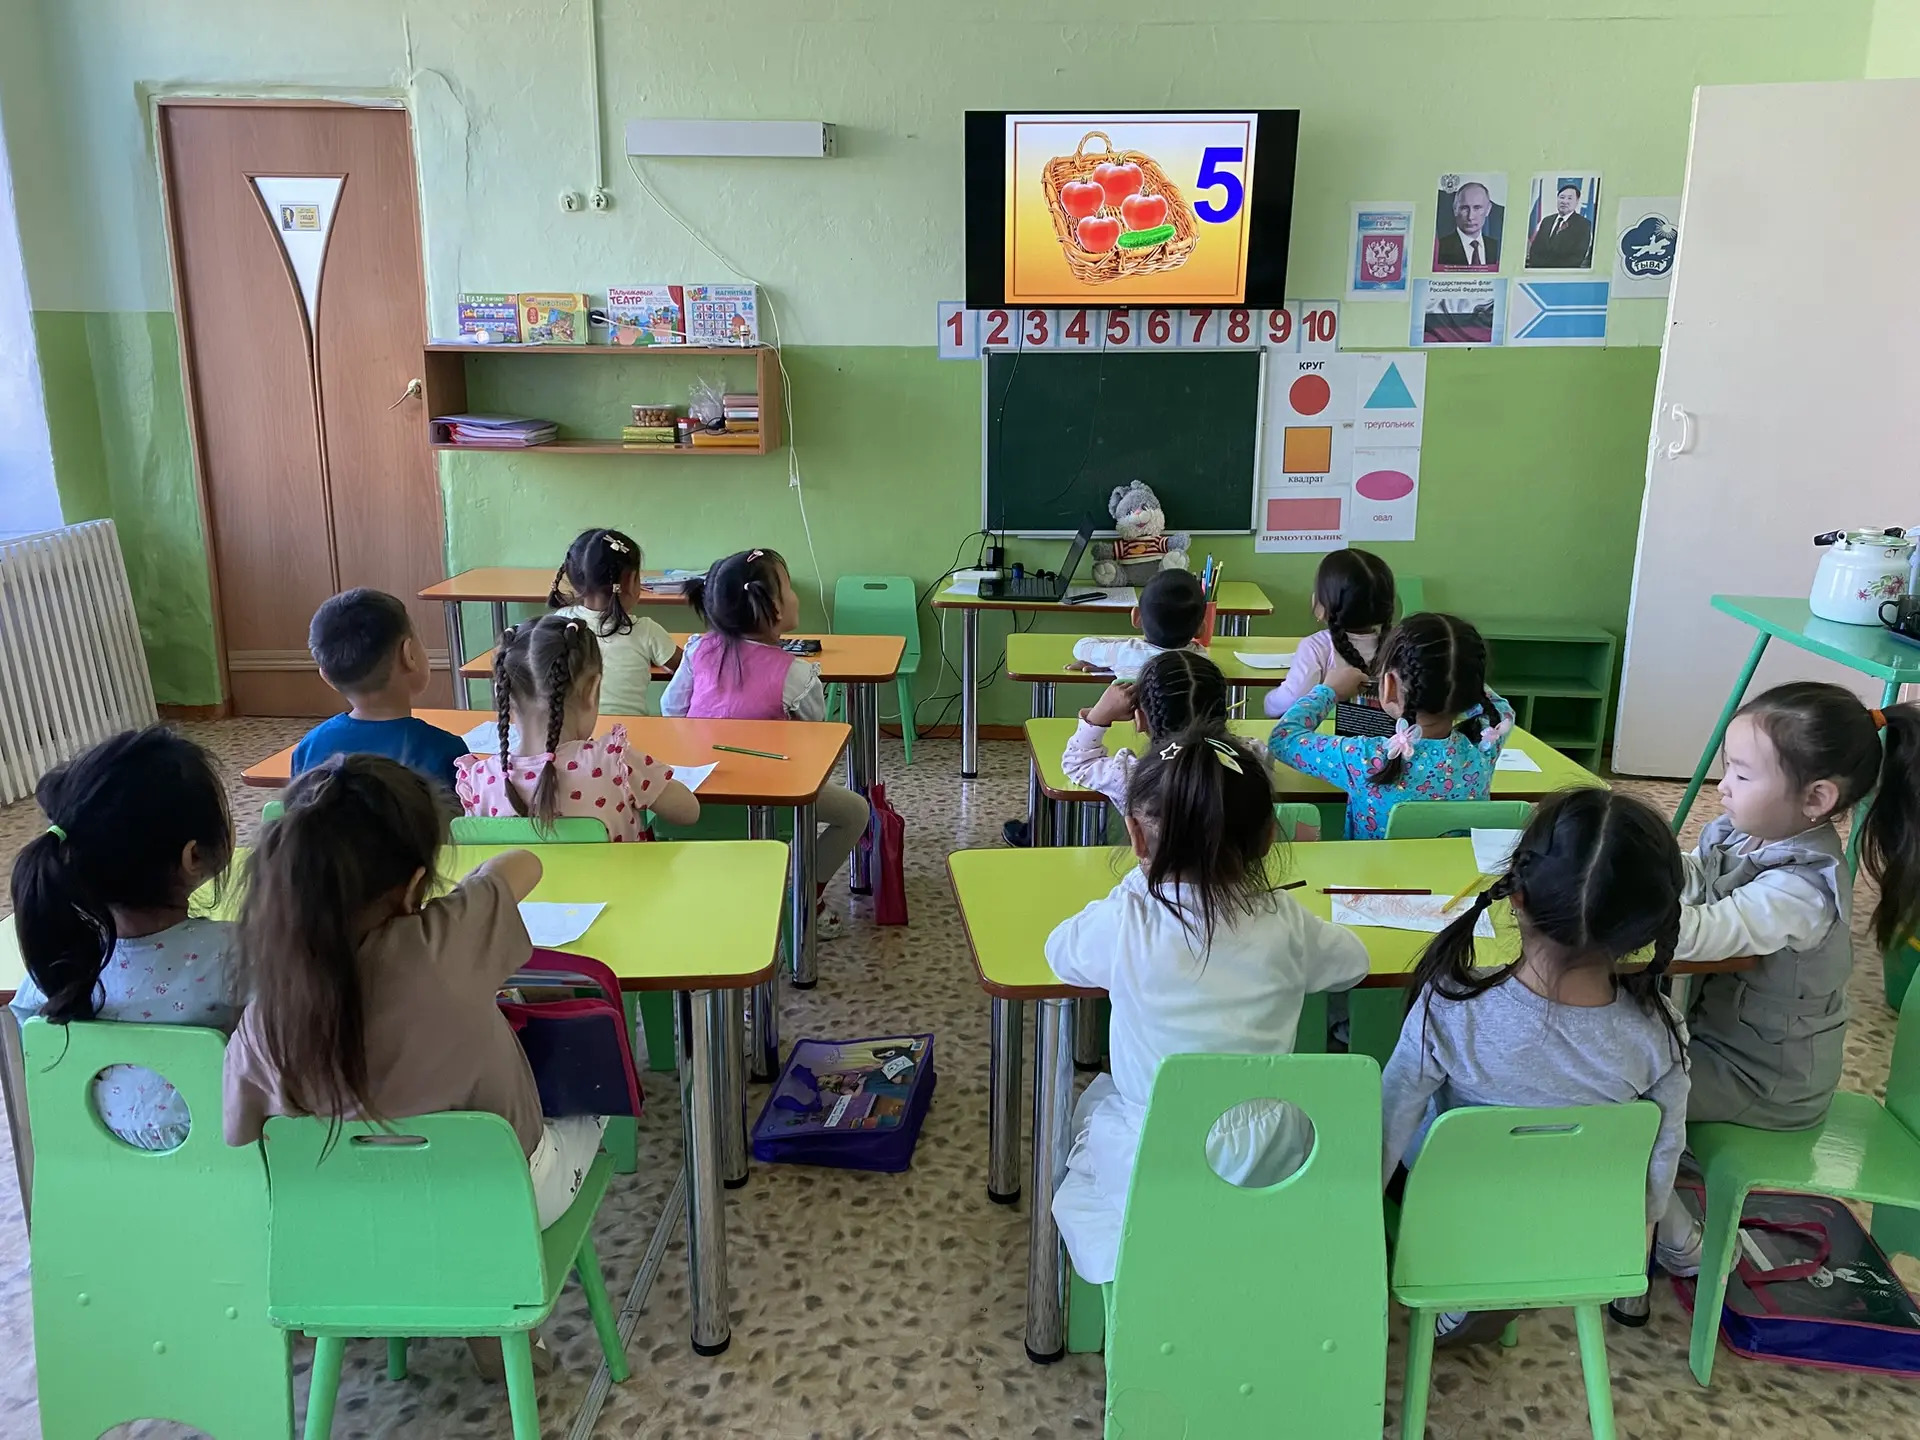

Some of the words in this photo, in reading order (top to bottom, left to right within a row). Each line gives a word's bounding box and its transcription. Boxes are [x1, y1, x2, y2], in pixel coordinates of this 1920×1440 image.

[1193, 147, 1244, 223] 5
[1634, 261, 1661, 270] ТЫВА
[609, 296, 642, 305] ТЕАТР
[742, 302, 754, 311] 36
[946, 311, 963, 346] 1
[986, 310, 1009, 344] 2
[1026, 310, 1048, 345] 3
[1065, 309, 1090, 344] 4
[1107, 309, 1130, 344] 5
[1147, 309, 1170, 344] 6
[1189, 309, 1212, 342] 7
[1227, 309, 1250, 343] 8
[1268, 309, 1292, 343] 9
[1302, 310, 1336, 342] 10
[1299, 362, 1325, 370] КРУГ
[1363, 421, 1415, 430] треугольник
[1288, 476, 1325, 484] квадрат
[1372, 514, 1393, 522] овал
